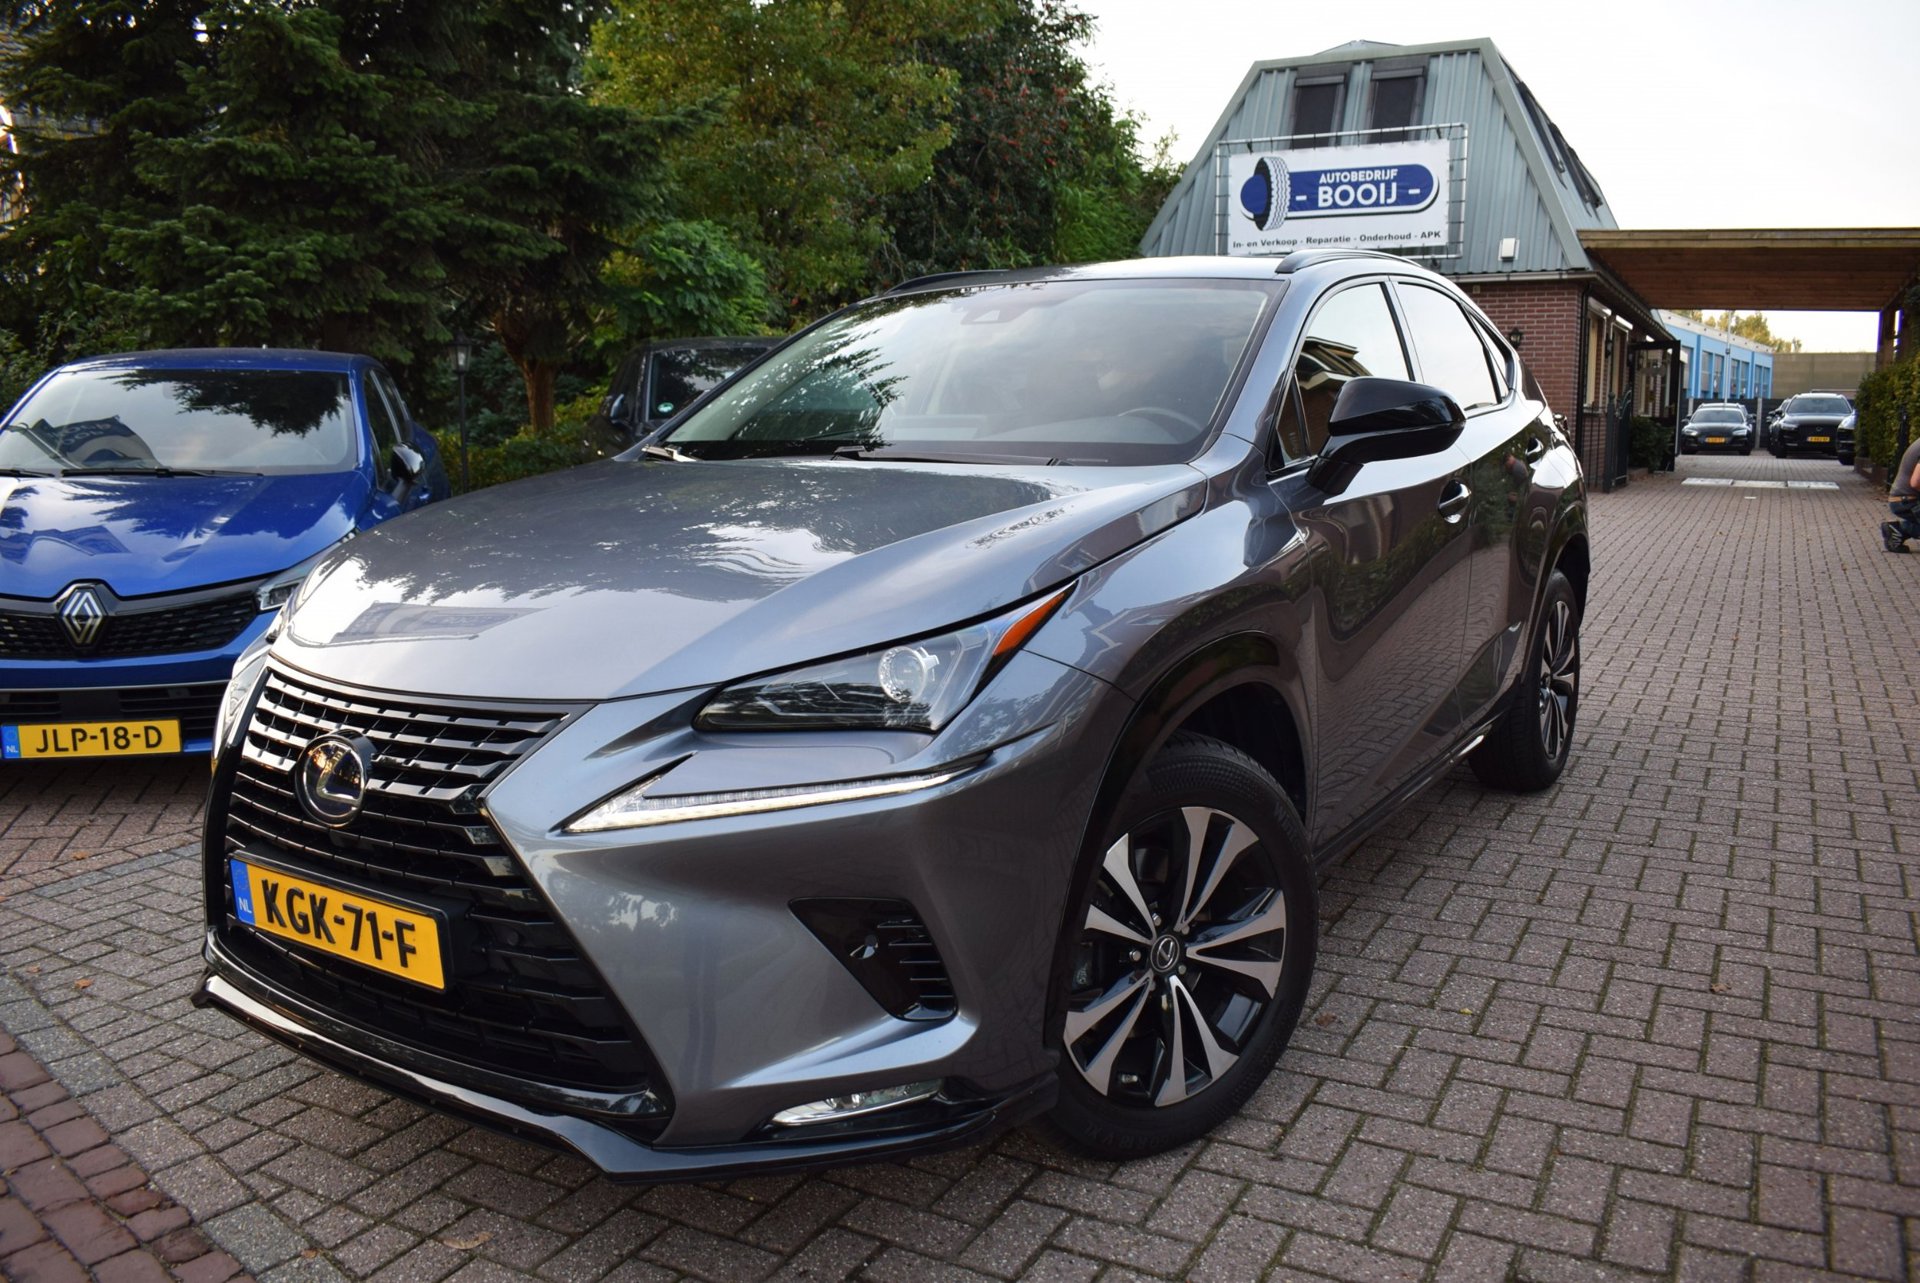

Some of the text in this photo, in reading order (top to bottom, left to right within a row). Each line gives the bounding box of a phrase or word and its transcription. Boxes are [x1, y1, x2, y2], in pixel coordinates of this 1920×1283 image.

[1319, 168, 1398, 184] AUTOBEDRIJF
[1318, 182, 1397, 208] BOOIJ
[1260, 239, 1298, 247] Verkoop
[1306, 235, 1351, 245] Reparatie
[1360, 232, 1411, 242] Onderhoud
[1420, 231, 1441, 239] APK
[36, 725, 163, 753] JLP-18-D
[238, 897, 252, 914] NL
[261, 878, 417, 968] KGK-71-F
